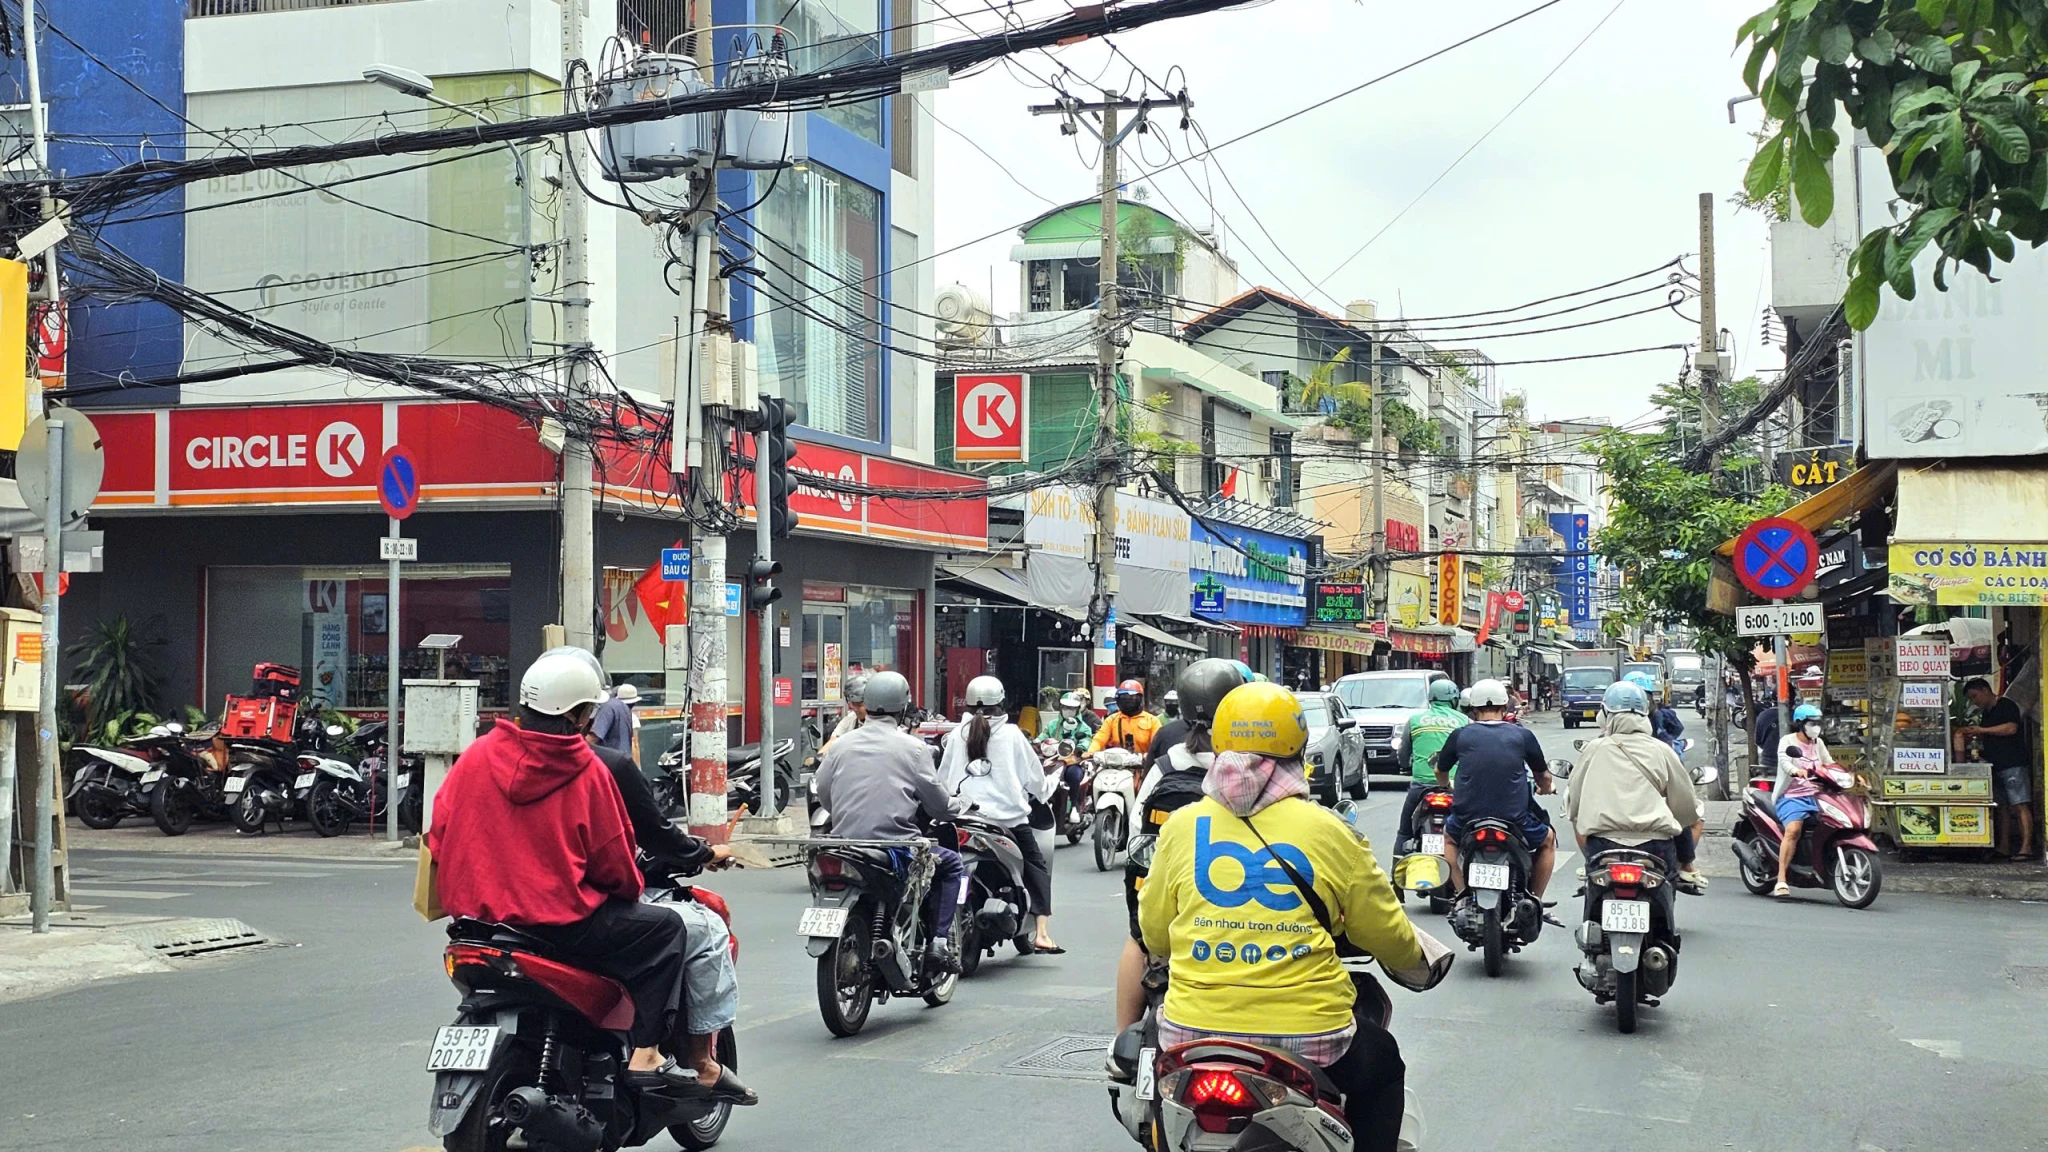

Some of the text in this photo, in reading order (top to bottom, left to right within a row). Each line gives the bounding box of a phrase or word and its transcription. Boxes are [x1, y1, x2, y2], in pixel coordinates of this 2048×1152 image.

[760, 111, 777, 121] 100
[265, 196, 308, 208] PRODUCT
[300, 297, 387, 314] Style of Gentle
[971, 389, 1013, 435] K
[186, 428, 364, 475] CIRCLE K
[1791, 450, 1839, 486] CẮT
[1126, 505, 1150, 534] BÁNH
[1152, 513, 1171, 539] FLAN
[1115, 536, 1131, 560] FFEE
[1825, 549, 1846, 569] NAM
[1983, 546, 2047, 568] BÁNH
[663, 562, 680, 575] BÀU
[1984, 574, 2016, 588] CÁC
[1744, 613, 1769, 629] 6:00
[1783, 612, 1815, 628] 21:00
[1322, 635, 1328, 647] 3
[1353, 641, 1372, 654] PPF
[1899, 643, 1947, 657] BÁNH MÌ
[1899, 661, 1949, 674] HEO QUAY
[1905, 685, 1940, 694] BÁNH MÌ
[1921, 698, 1940, 706] CHAY
[1418, 714, 1460, 727] Grab
[1897, 750, 1941, 760] BÁNH MÌ
[1924, 761, 1938, 771] CÁ
[1194, 815, 1314, 912] be
[1476, 866, 1501, 877] 53-Z1
[1474, 876, 1503, 887] 8759
[808, 908, 840, 921] 76-H1
[1610, 903, 1641, 916] 85-C1
[800, 921, 841, 935] 374.53
[1194, 916, 1313, 935] Bên nhau trọn đường
[1605, 917, 1646, 930] 413.86
[442, 1028, 490, 1047] 59-P3
[431, 1048, 487, 1068] 207.81
